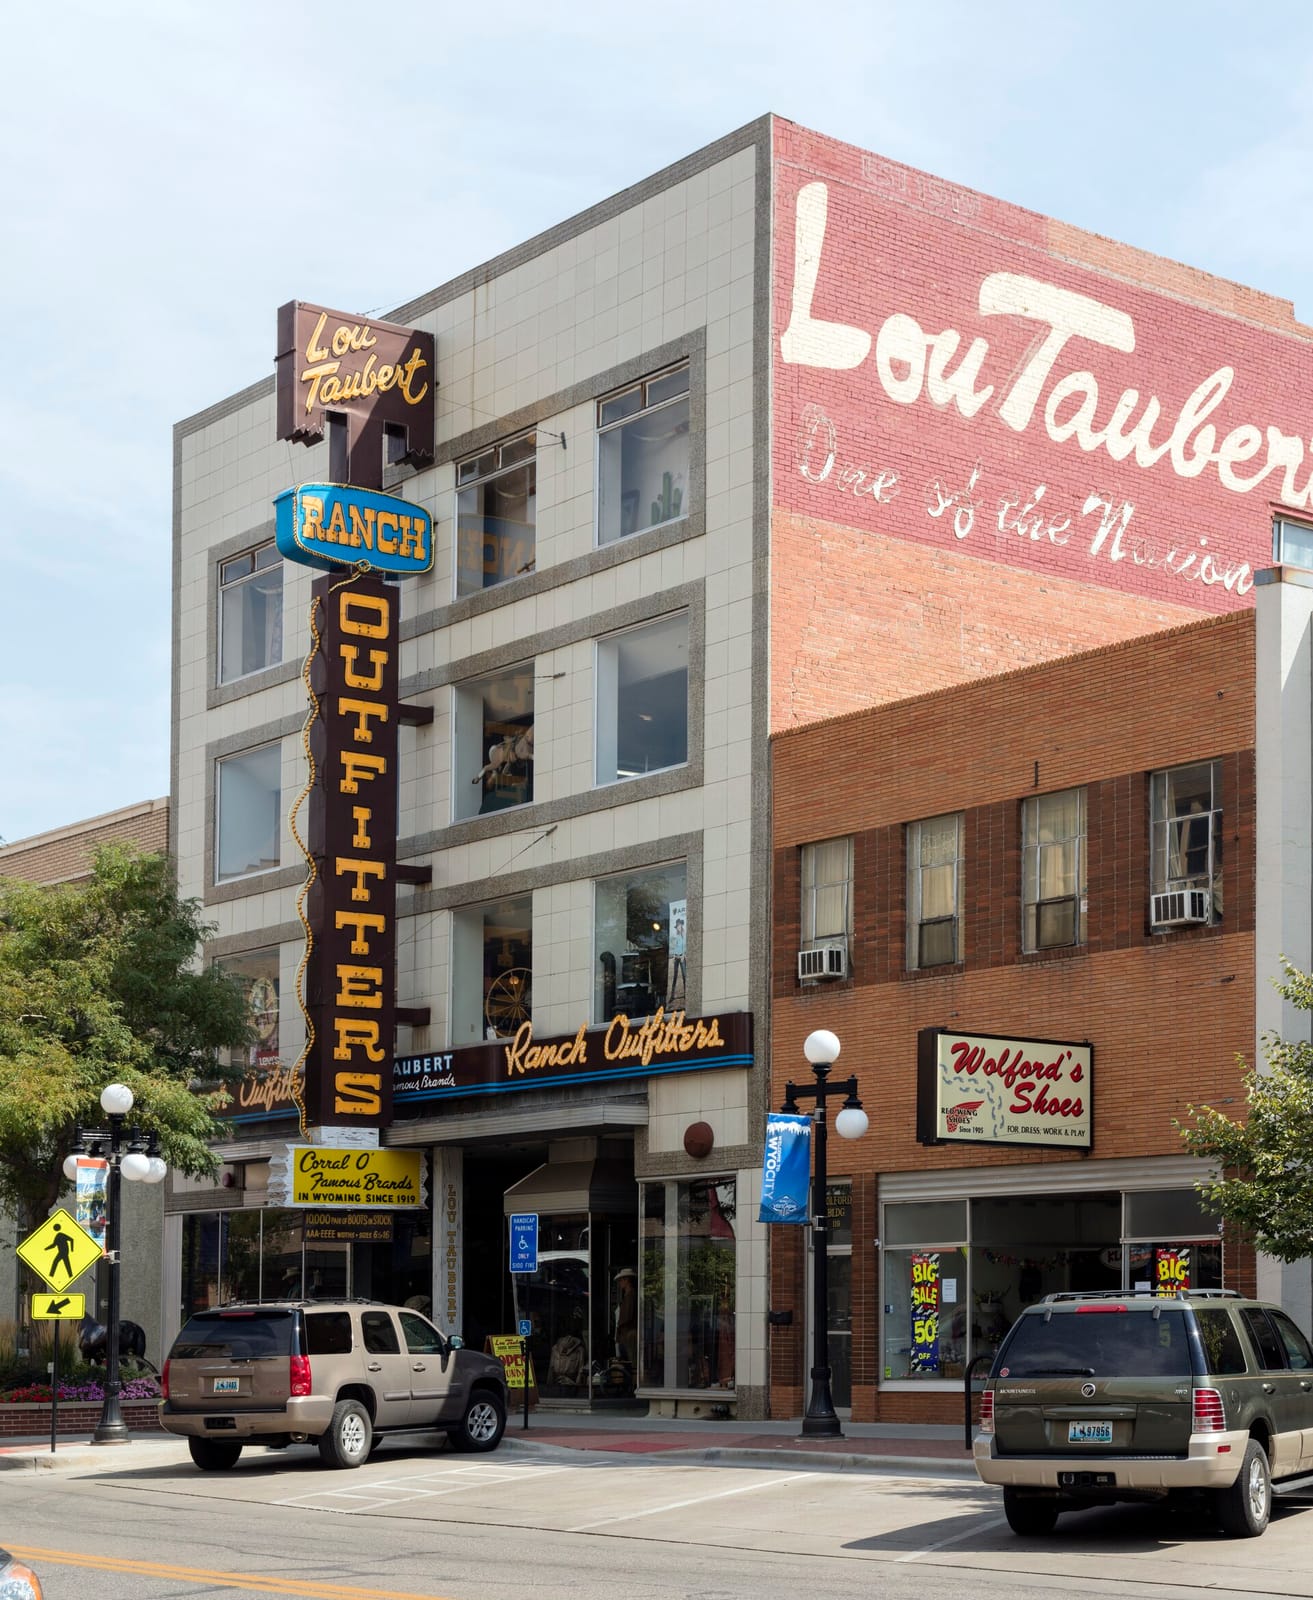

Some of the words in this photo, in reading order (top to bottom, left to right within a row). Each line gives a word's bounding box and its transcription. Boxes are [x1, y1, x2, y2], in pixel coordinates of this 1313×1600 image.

[305, 311, 377, 364] Lou
[781, 182, 995, 418] Lou
[979, 271, 1313, 507] Tauber
[301, 347, 427, 415] Taubert
[302, 495, 425, 561] RANCH
[333, 591, 390, 1117] OUTFITTERS
[505, 1020, 588, 1076] Ranch
[604, 1005, 725, 1066] Outfitters
[393, 1054, 454, 1075] AUBERT
[951, 1042, 1084, 1088] Wolford's
[393, 1080, 420, 1091] mous
[421, 1072, 456, 1088] Brands
[1009, 1082, 1084, 1117] Shoes
[941, 1107, 954, 1115] RED
[949, 1116, 970, 1124] SHOES
[1007, 1125, 1019, 1133] FOR
[1043, 1128, 1062, 1136] WORK
[1071, 1129, 1086, 1137] PLAY
[299, 1151, 351, 1173] Corral
[763, 1136, 778, 1200] WYOCITY
[310, 1172, 361, 1191] Famous
[363, 1173, 414, 1191] Brands
[298, 1192, 309, 1201] IN
[312, 1193, 361, 1202] WYOMING
[365, 1194, 394, 1203] SINCE
[396, 1195, 416, 1204] 1919
[446, 1184, 457, 1224] LOU
[347, 1213, 368, 1226] BOOTS
[913, 1262, 938, 1283] BIG
[1159, 1259, 1187, 1281] BIG
[913, 1286, 937, 1305] SALE
[918, 1352, 931, 1360] OFF
